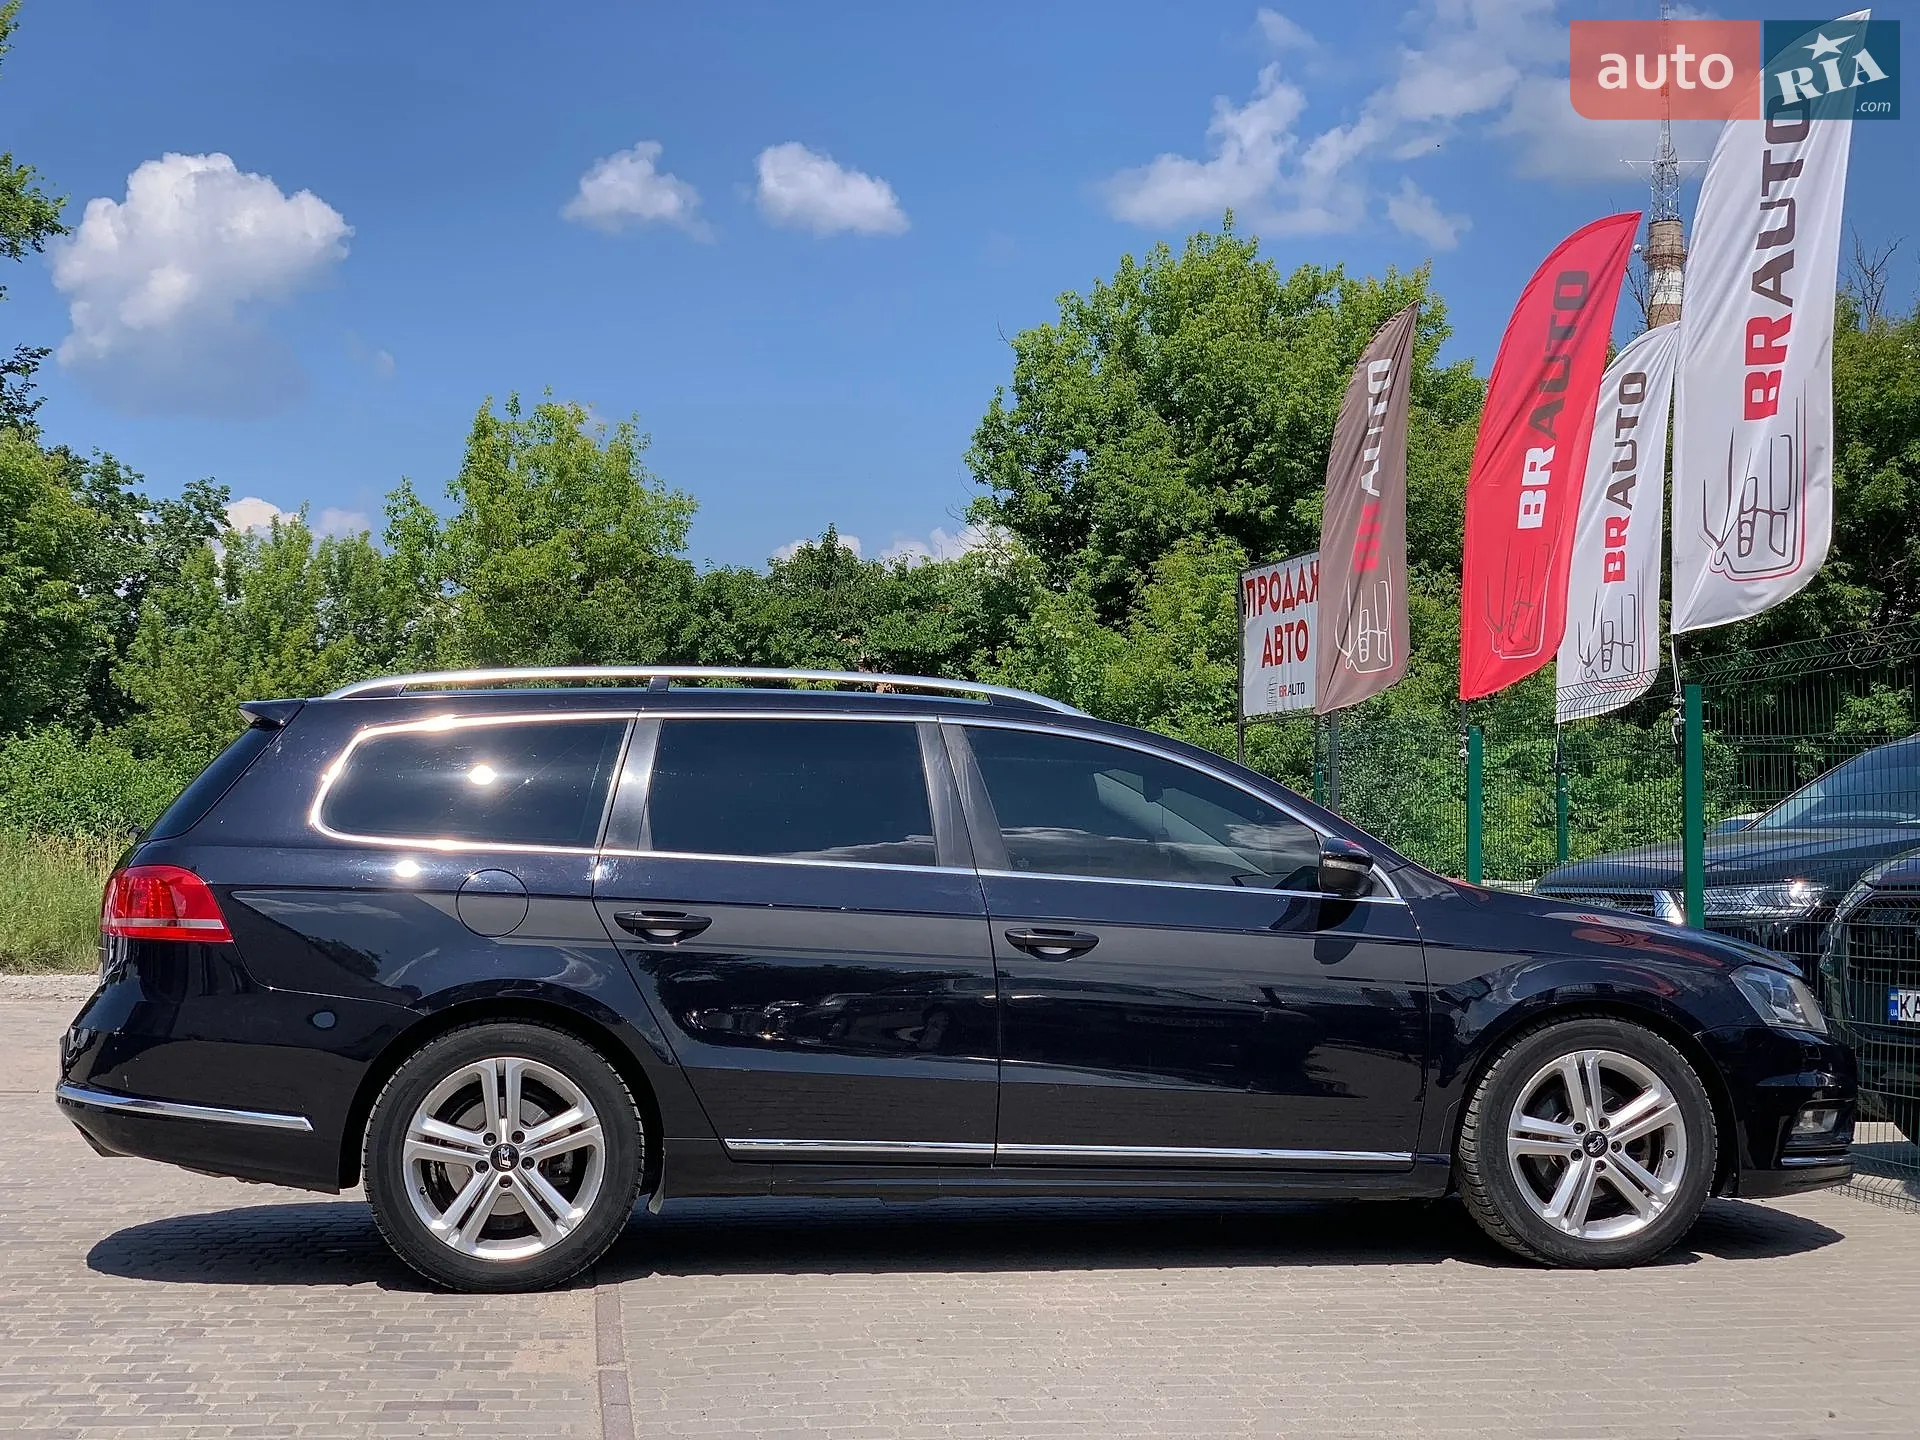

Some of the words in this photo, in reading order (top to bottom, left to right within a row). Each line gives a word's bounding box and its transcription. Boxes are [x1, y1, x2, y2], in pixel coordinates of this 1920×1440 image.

[1517, 270, 1589, 530] BRAUTO
[1603, 371, 1647, 584] BRAUTO
[1262, 618, 1309, 668] АВТО
